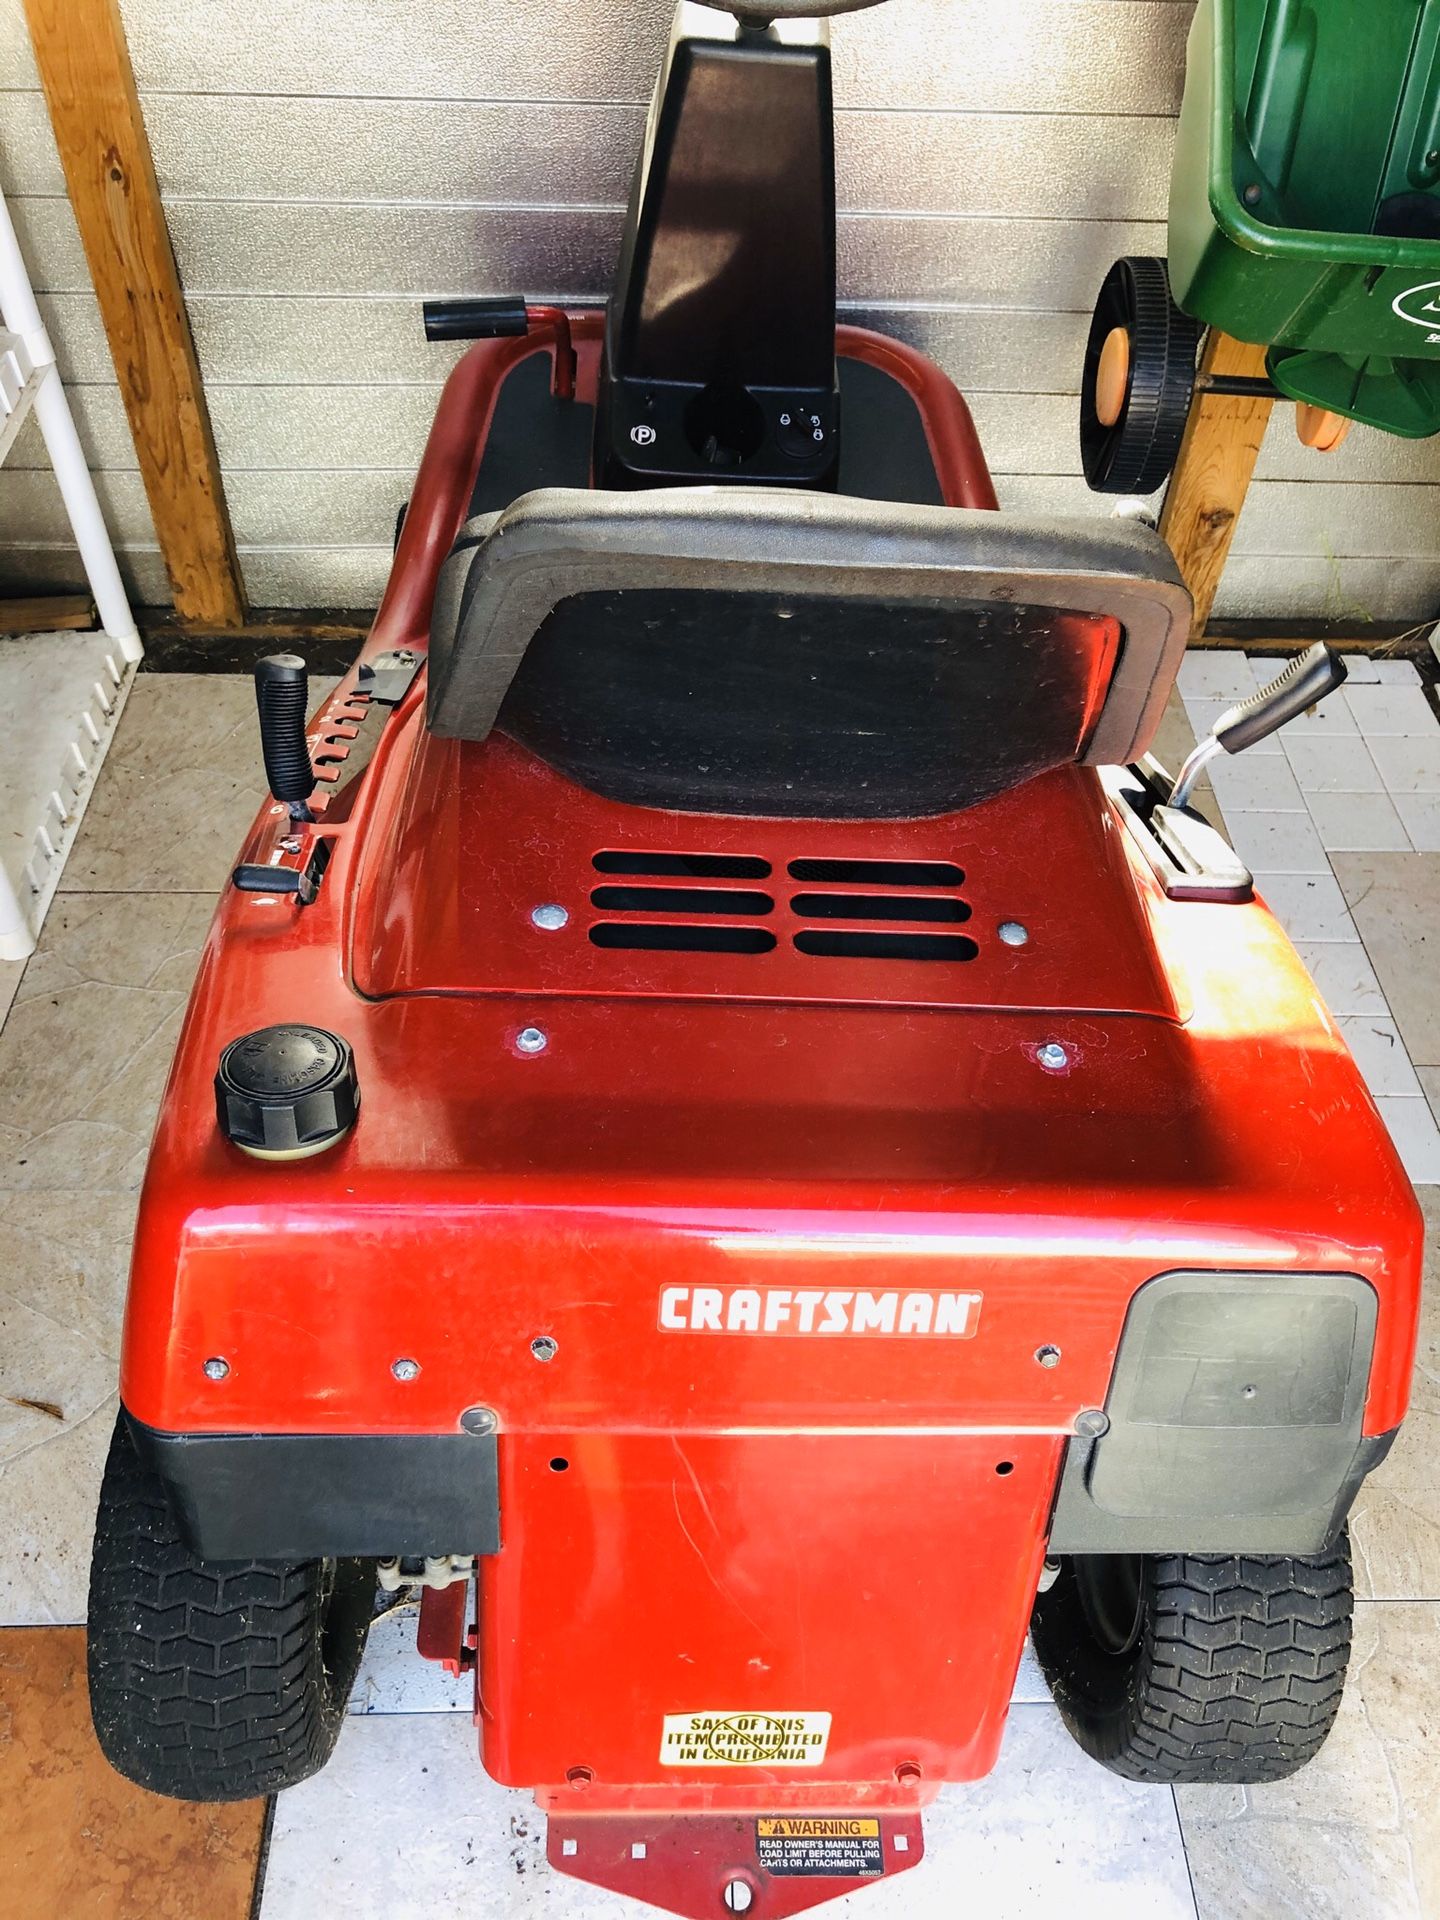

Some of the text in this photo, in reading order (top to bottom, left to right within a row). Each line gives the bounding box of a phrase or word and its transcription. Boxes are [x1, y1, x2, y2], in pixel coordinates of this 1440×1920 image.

[660, 1287, 972, 1334] CRAFTSMAN
[738, 1718, 759, 1731] OF
[765, 1718, 805, 1731] THIS
[668, 1733, 823, 1745] ITEM PROHIBITED
[679, 1748, 697, 1760] IN
[788, 1821, 861, 1835] WARNING
[759, 1840, 880, 1849] READ OWNER'S MANUAL FOR
[760, 1849, 880, 1858] LOAD LIMIT BEFORE PULLING
[760, 1859, 868, 1868] CARTS OR ATTACHMENTS.
